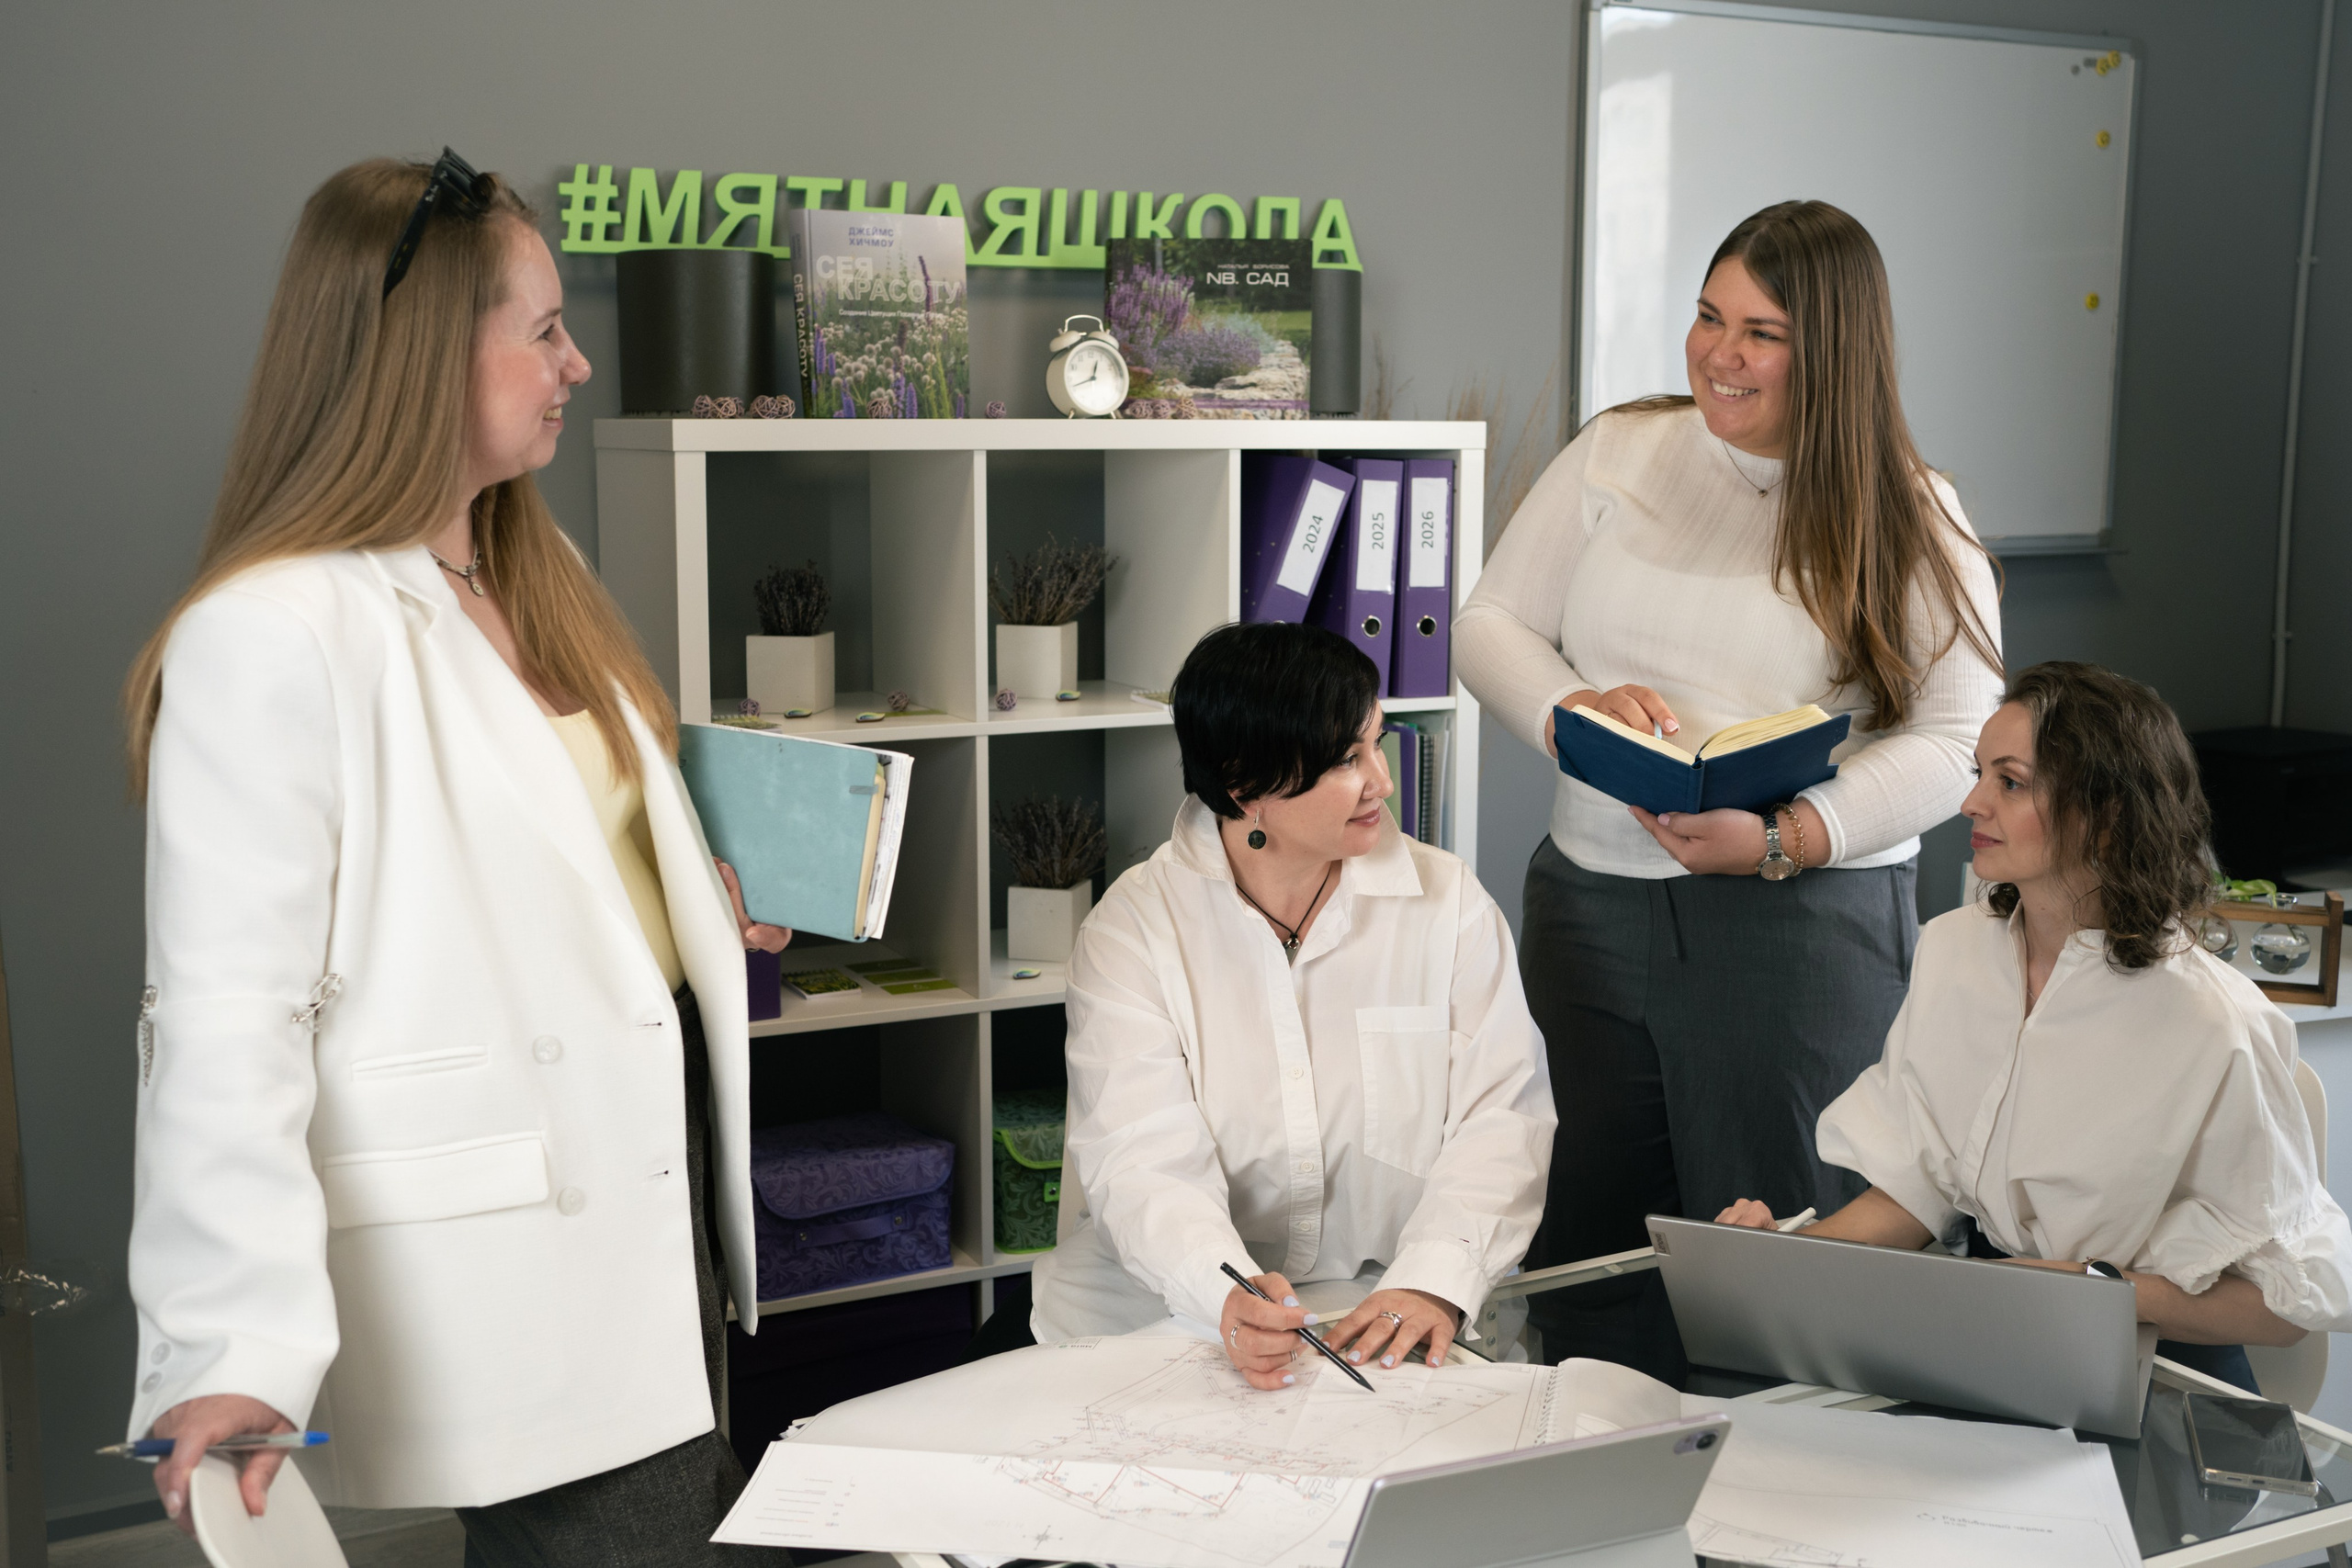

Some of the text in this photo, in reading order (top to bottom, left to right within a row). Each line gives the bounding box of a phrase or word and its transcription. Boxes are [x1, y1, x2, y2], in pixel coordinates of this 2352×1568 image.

[848, 226, 894, 237] ДЖЕЙМС
[848, 238, 894, 248] ХИЧМОУ
[816, 255, 873, 280] СЕЯ
[1246, 272, 1289, 288] САД
[793, 274, 804, 303] СЕЯ
[838, 277, 960, 303] КРАСОТУ
[796, 308, 808, 378] КРАСОТУ
[1302, 514, 1324, 554] 2024
[1372, 512, 1385, 550] 2025
[1421, 511, 1434, 549] 2026
